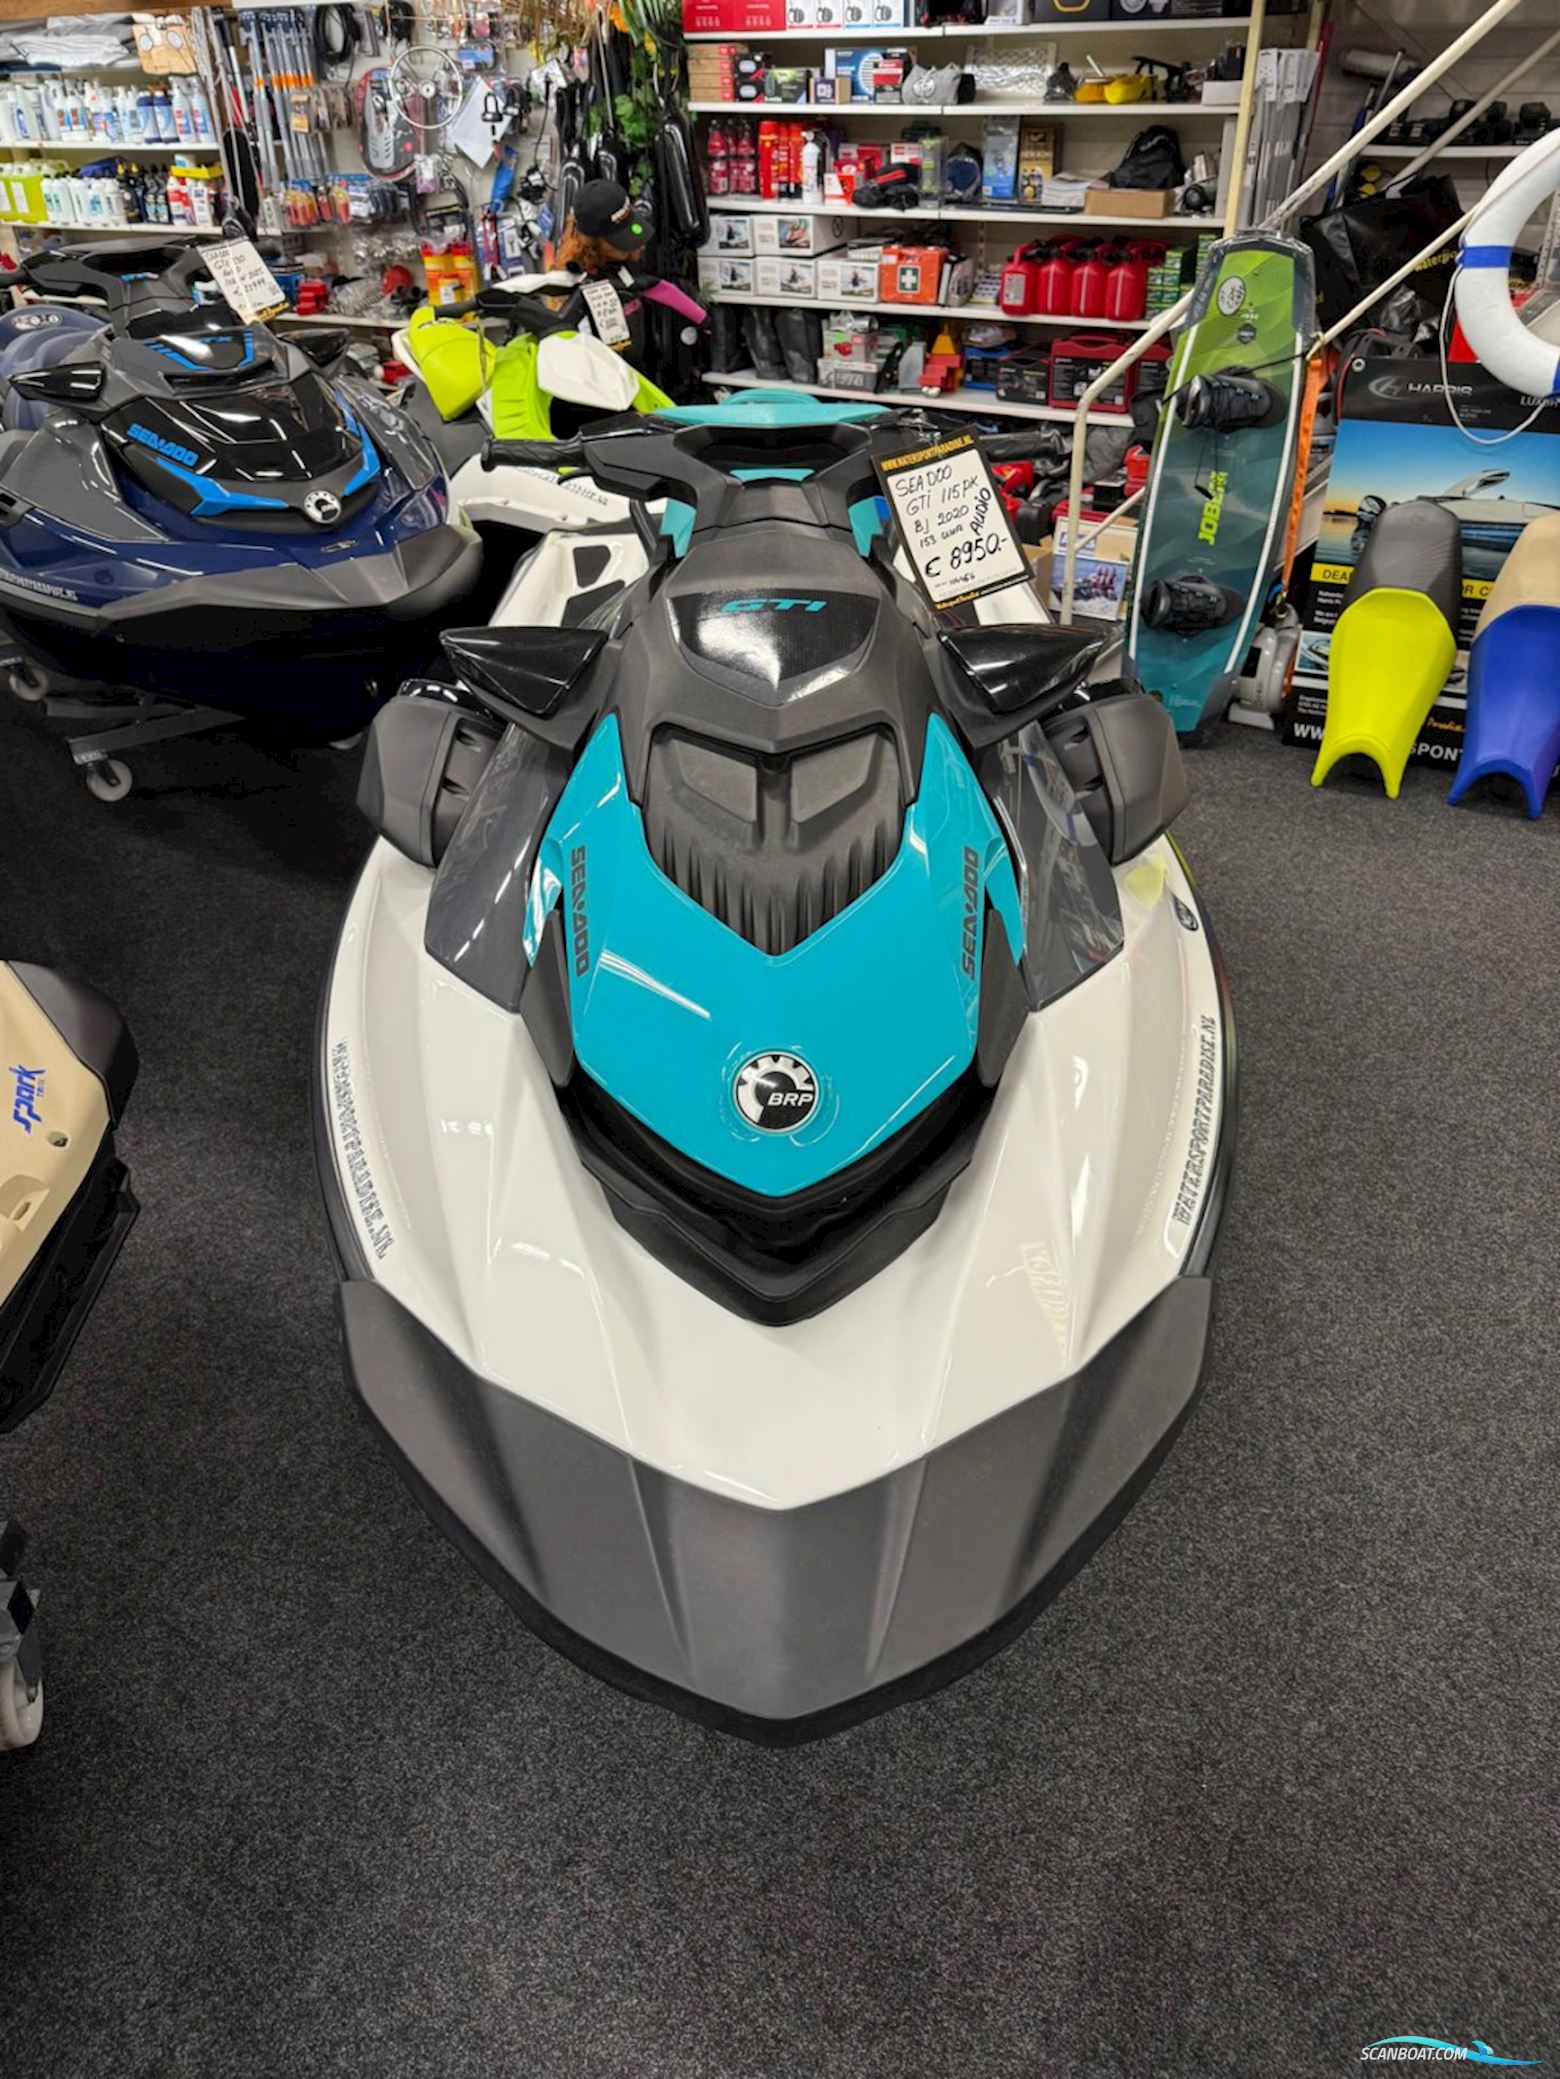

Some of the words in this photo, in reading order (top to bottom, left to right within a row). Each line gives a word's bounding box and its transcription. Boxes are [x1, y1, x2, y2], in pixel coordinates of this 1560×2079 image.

[937, 505, 970, 526] 2020
[920, 535, 937, 549] 153
[1323, 569, 1348, 581] DEA
[720, 600, 827, 613] GTI
[1294, 722, 1325, 741] WW
[767, 1092, 813, 1107] BRP
[1172, 1015, 1215, 1226] WATERSPORTPARADISE.NL
